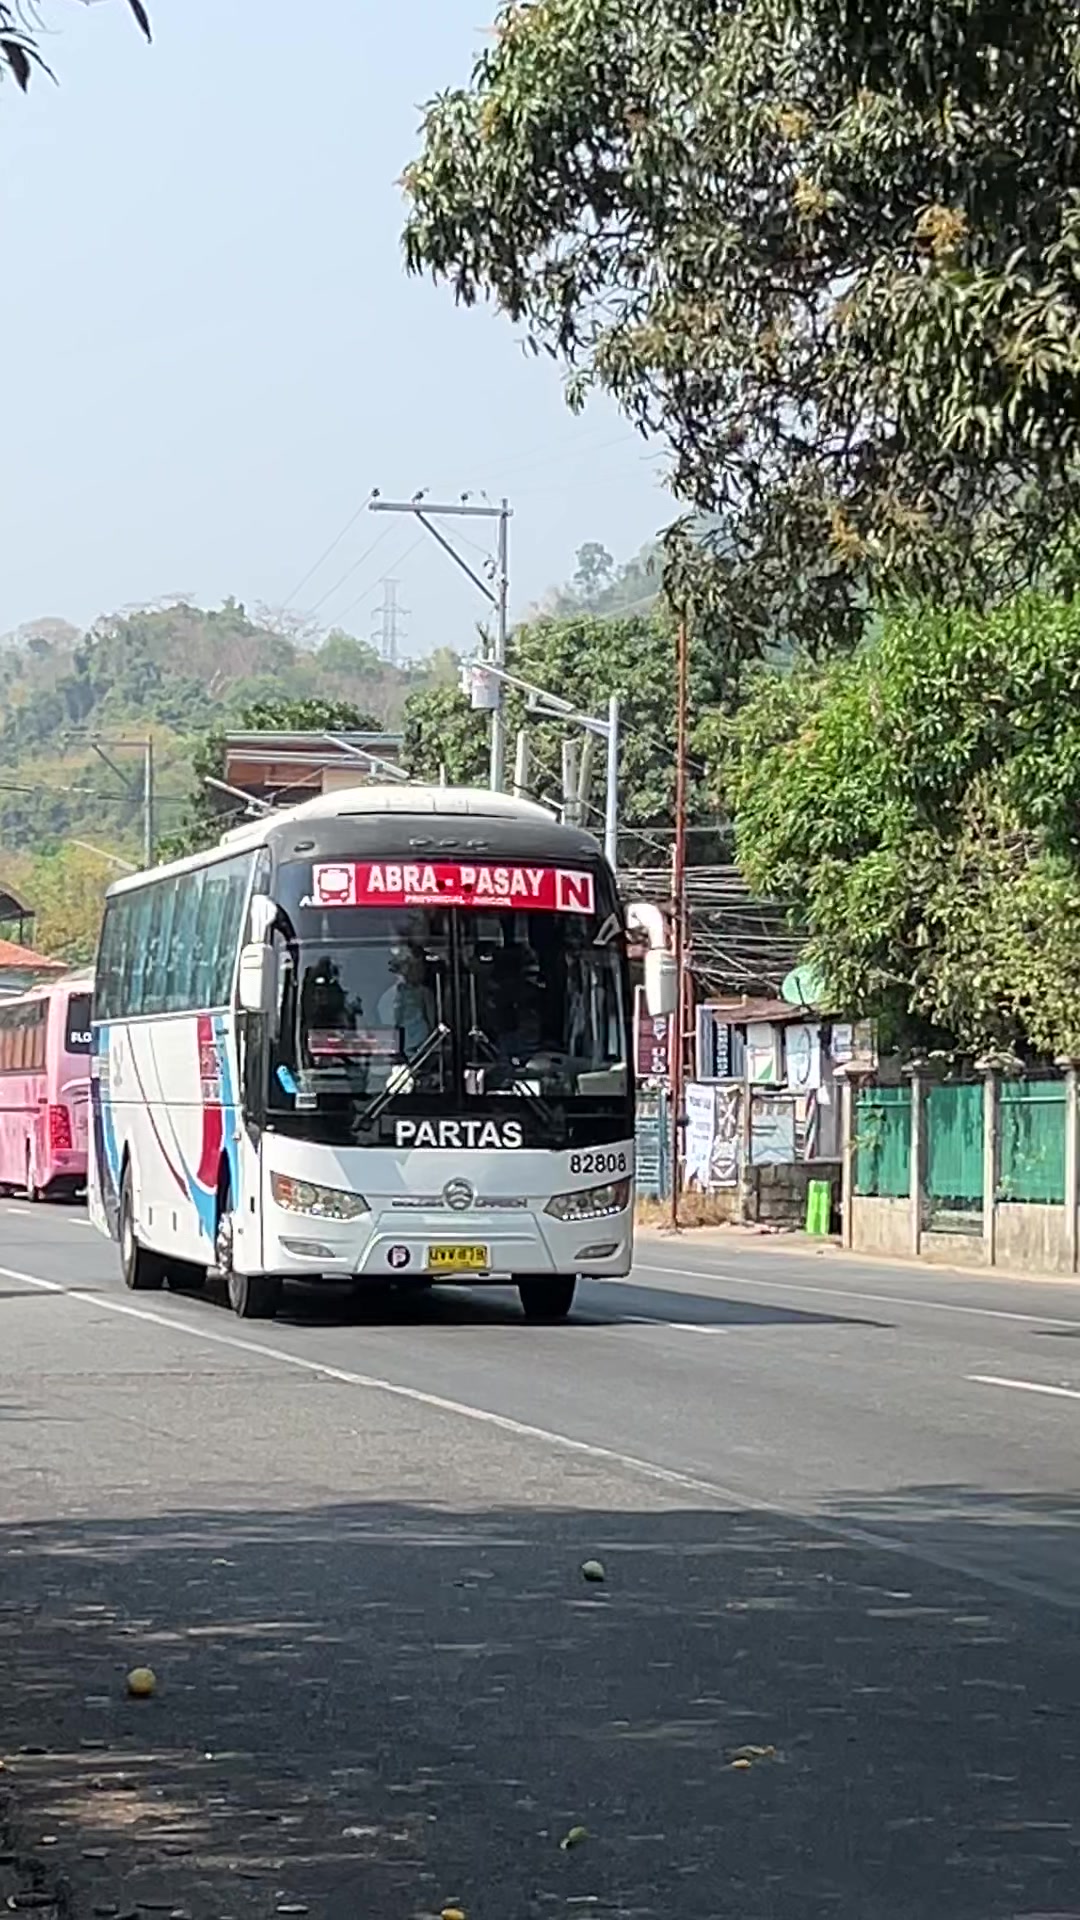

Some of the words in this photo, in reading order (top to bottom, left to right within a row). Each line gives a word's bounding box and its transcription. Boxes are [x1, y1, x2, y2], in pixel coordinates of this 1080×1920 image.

[367, 865, 440, 893] ABRA
[460, 866, 544, 897] PASAY
[561, 876, 591, 908] N
[70, 1031, 93, 1044] FLO
[395, 1120, 523, 1148] PARTAS
[570, 1153, 627, 1174] 82808
